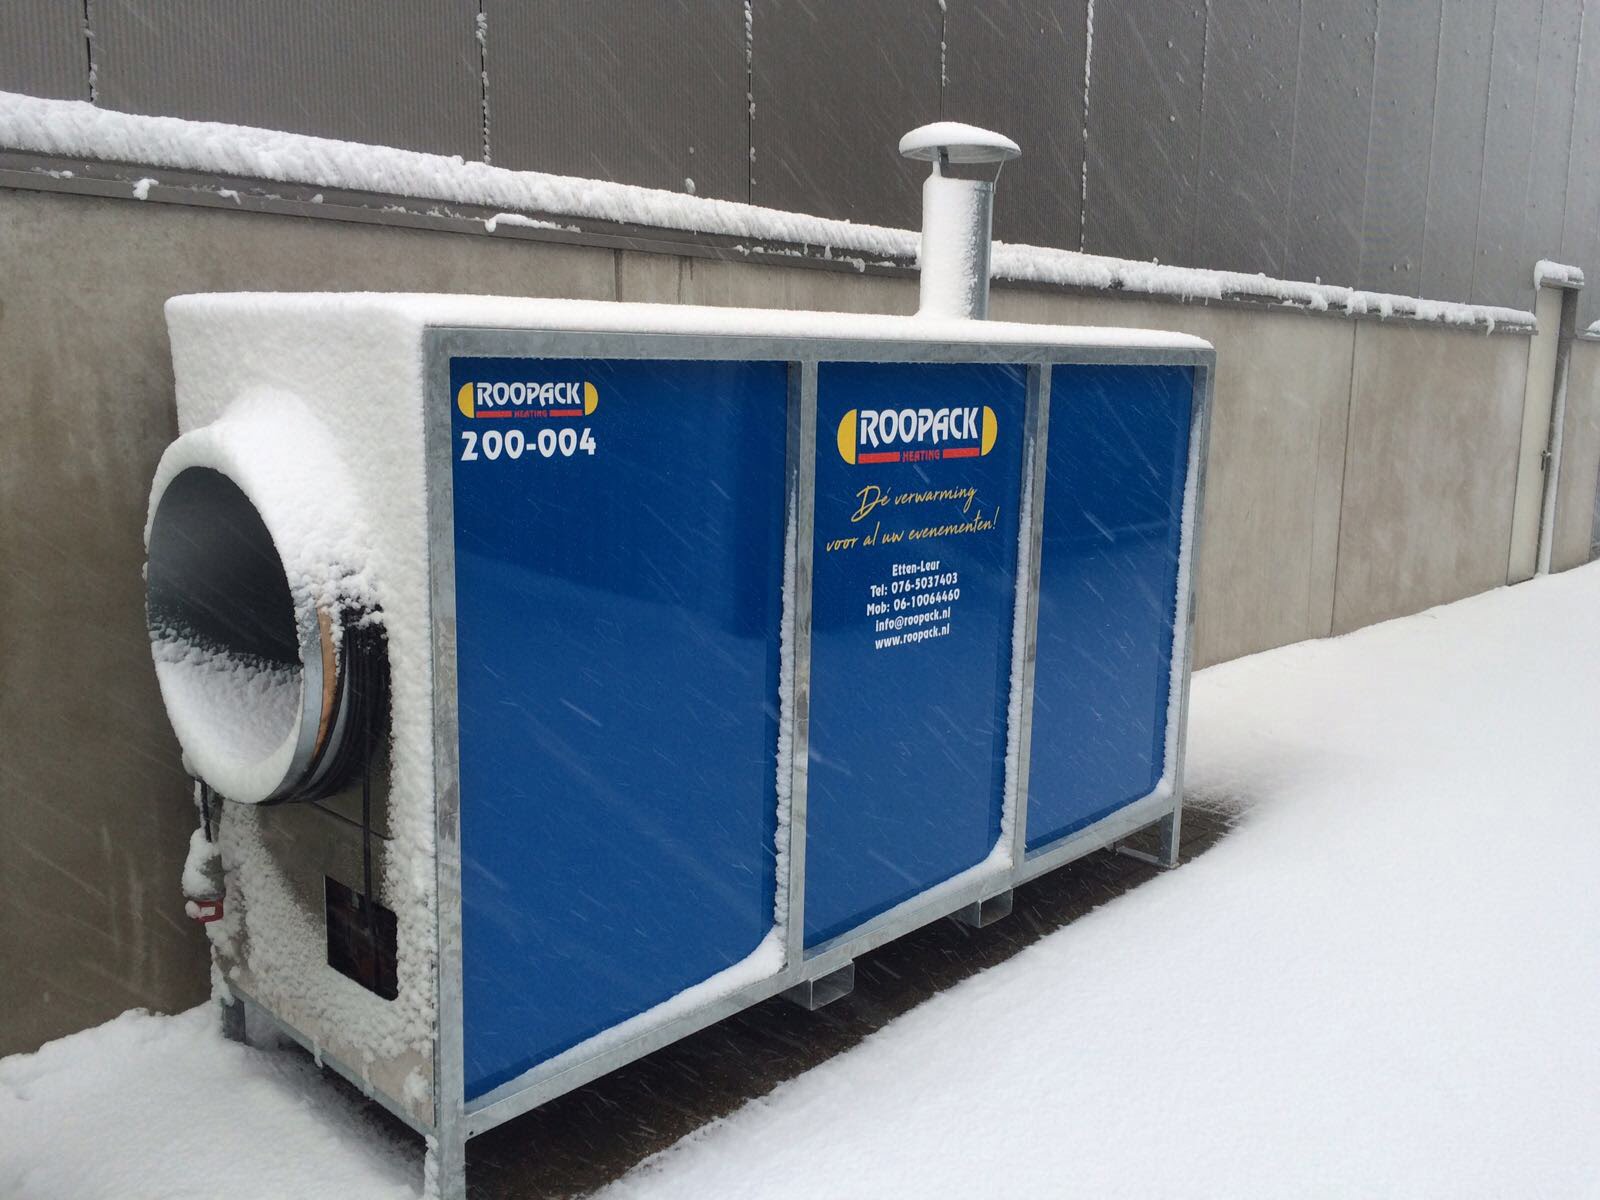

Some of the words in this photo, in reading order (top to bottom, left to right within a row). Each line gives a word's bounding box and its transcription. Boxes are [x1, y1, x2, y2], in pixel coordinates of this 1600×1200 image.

[476, 382, 581, 408] ROOPACK
[860, 407, 979, 448] ROOPACK
[460, 428, 596, 461] 200-004
[902, 449, 940, 462] HEATING
[851, 485, 891, 523] Dé
[894, 486, 977, 514] verwarming
[826, 537, 858, 552] voor
[863, 521, 880, 546] al
[882, 530, 905, 545] uw
[908, 506, 1000, 540] evenementen!
[892, 560, 940, 577] Etten-Leur
[870, 584, 888, 598] Tel:
[891, 572, 958, 594] 076-5037403
[866, 602, 890, 616] Mob:
[893, 588, 960, 611] 06-10064460
[875, 606, 951, 632] info@roopack.nl
[875, 623, 950, 650] www.roopack.nl
